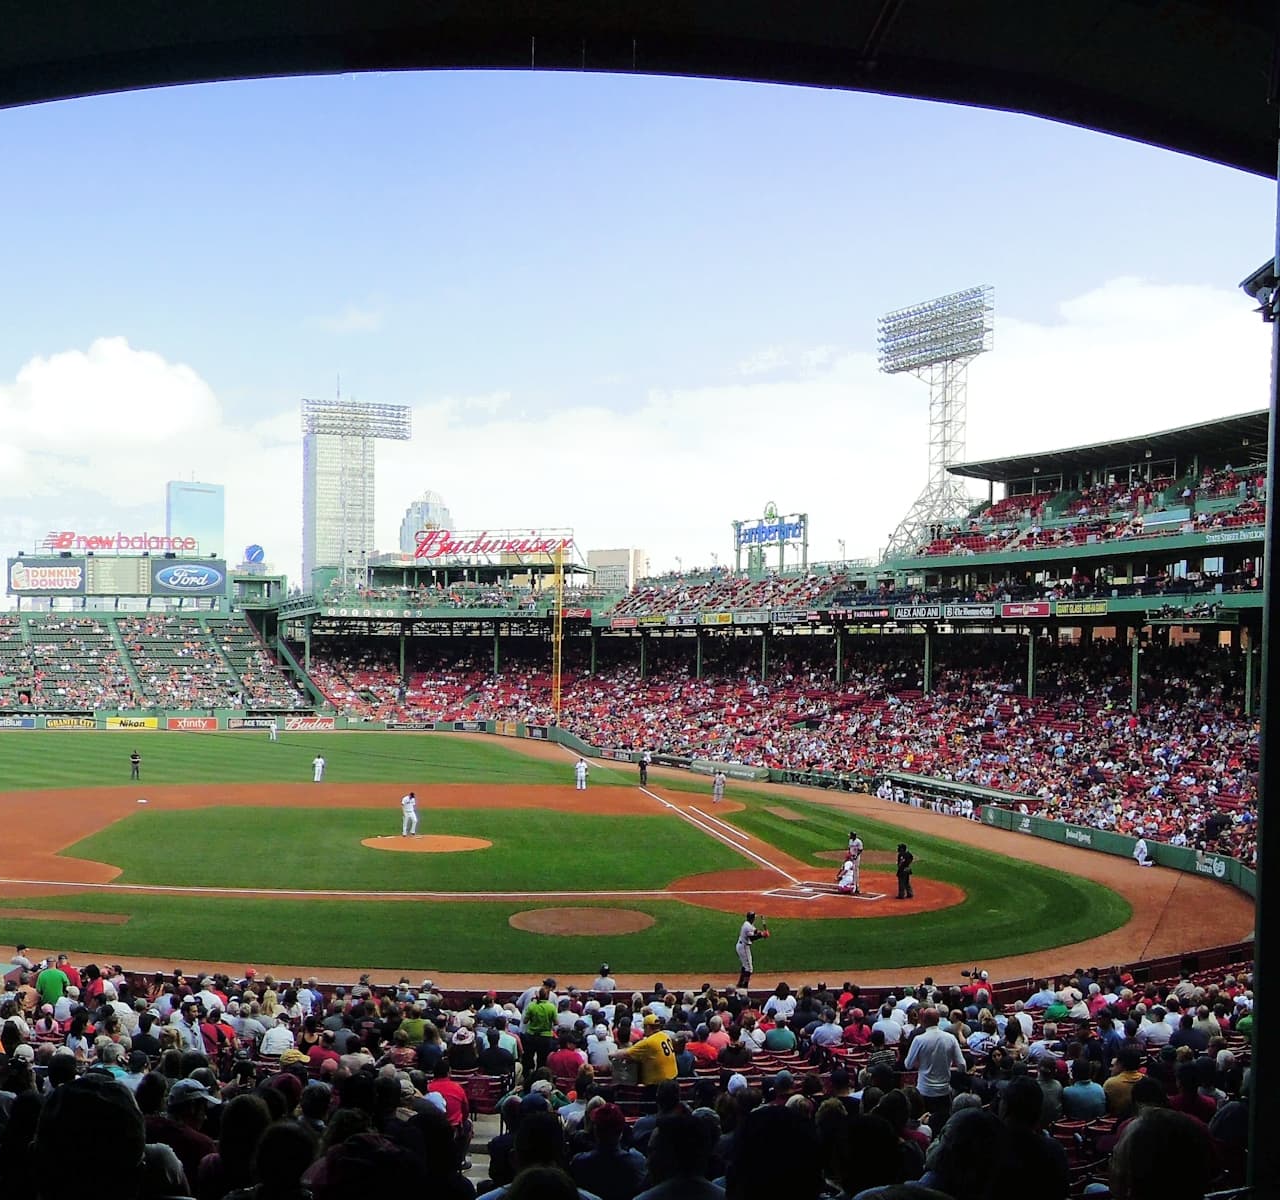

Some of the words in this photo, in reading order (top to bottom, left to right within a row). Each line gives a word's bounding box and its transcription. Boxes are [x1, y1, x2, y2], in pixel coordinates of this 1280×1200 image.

[77, 534, 114, 550] new
[117, 532, 196, 550] balance
[414, 530, 574, 559] Budweiser
[31, 568, 80, 578] DUNKIN'
[169, 568, 209, 587] Ford
[31, 578, 78, 588] DONUTS
[896, 606, 911, 617] ALEX
[912, 606, 926, 617] AND
[927, 606, 939, 616] ANI
[47, 717, 77, 728] GRANITE
[119, 719, 145, 728] Nikon
[176, 718, 208, 729] xfinity
[243, 719, 255, 727] ACE
